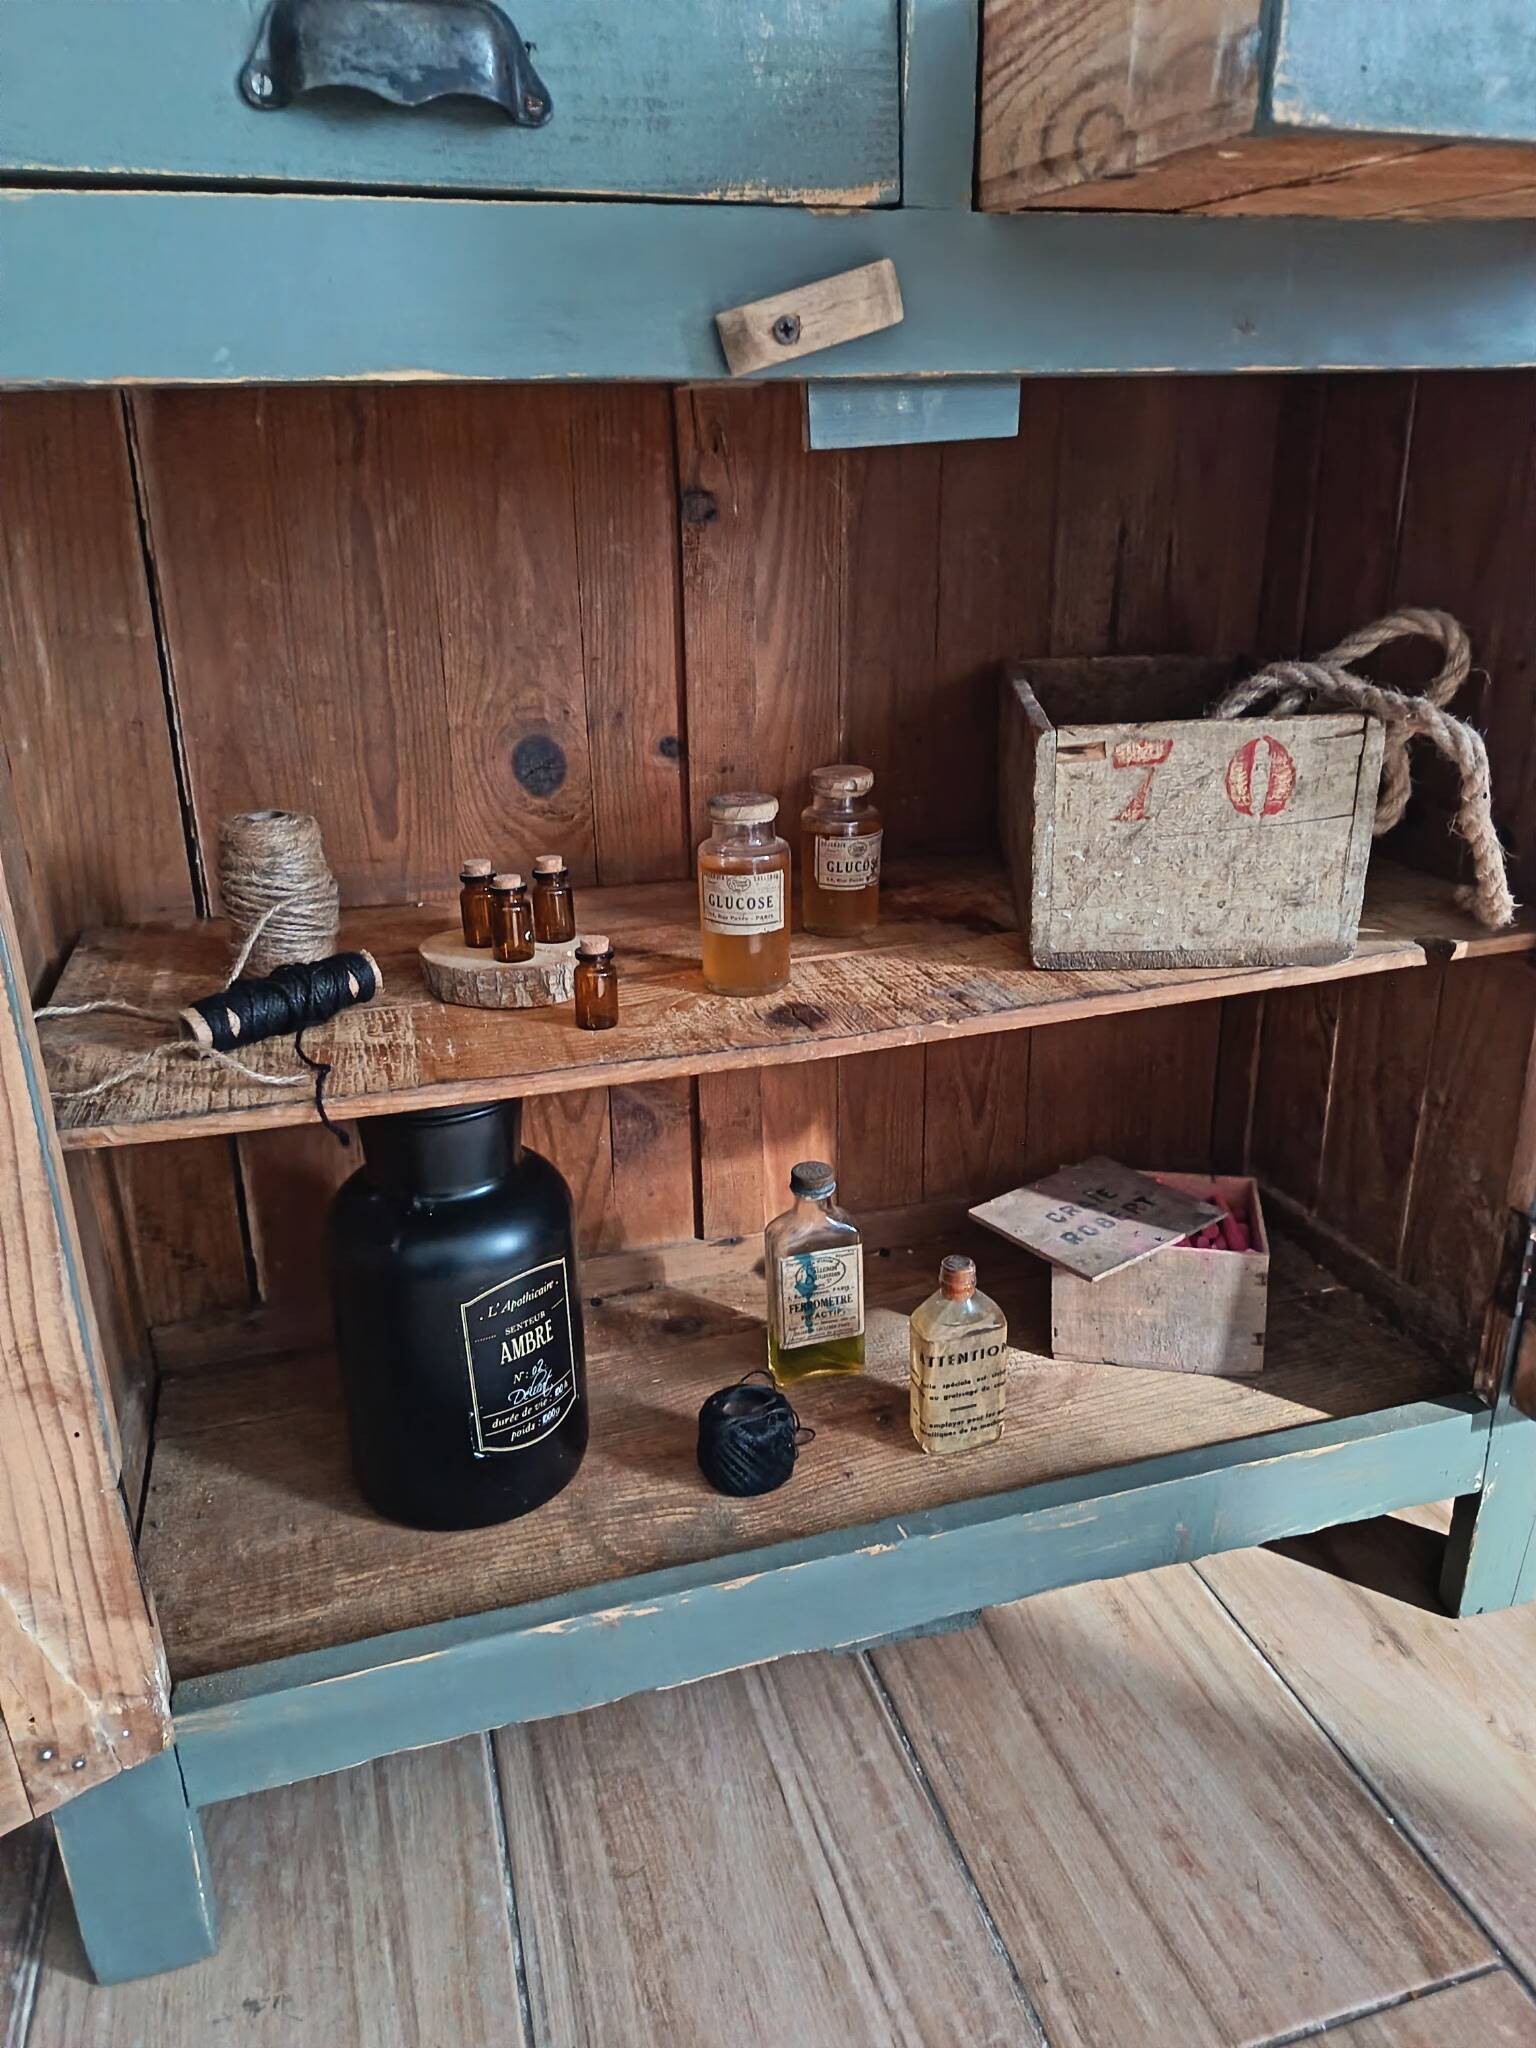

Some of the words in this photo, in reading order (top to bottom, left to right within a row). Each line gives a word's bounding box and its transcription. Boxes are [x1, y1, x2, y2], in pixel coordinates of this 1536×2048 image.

[708, 893, 774, 911] GLUCOSE
[505, 1310, 546, 1336] SENTEUR
[500, 1318, 554, 1365] AMBRE
[920, 1342, 1007, 1369] ATTENTION
[521, 1403, 534, 1419] de
[511, 1420, 536, 1442] poids
